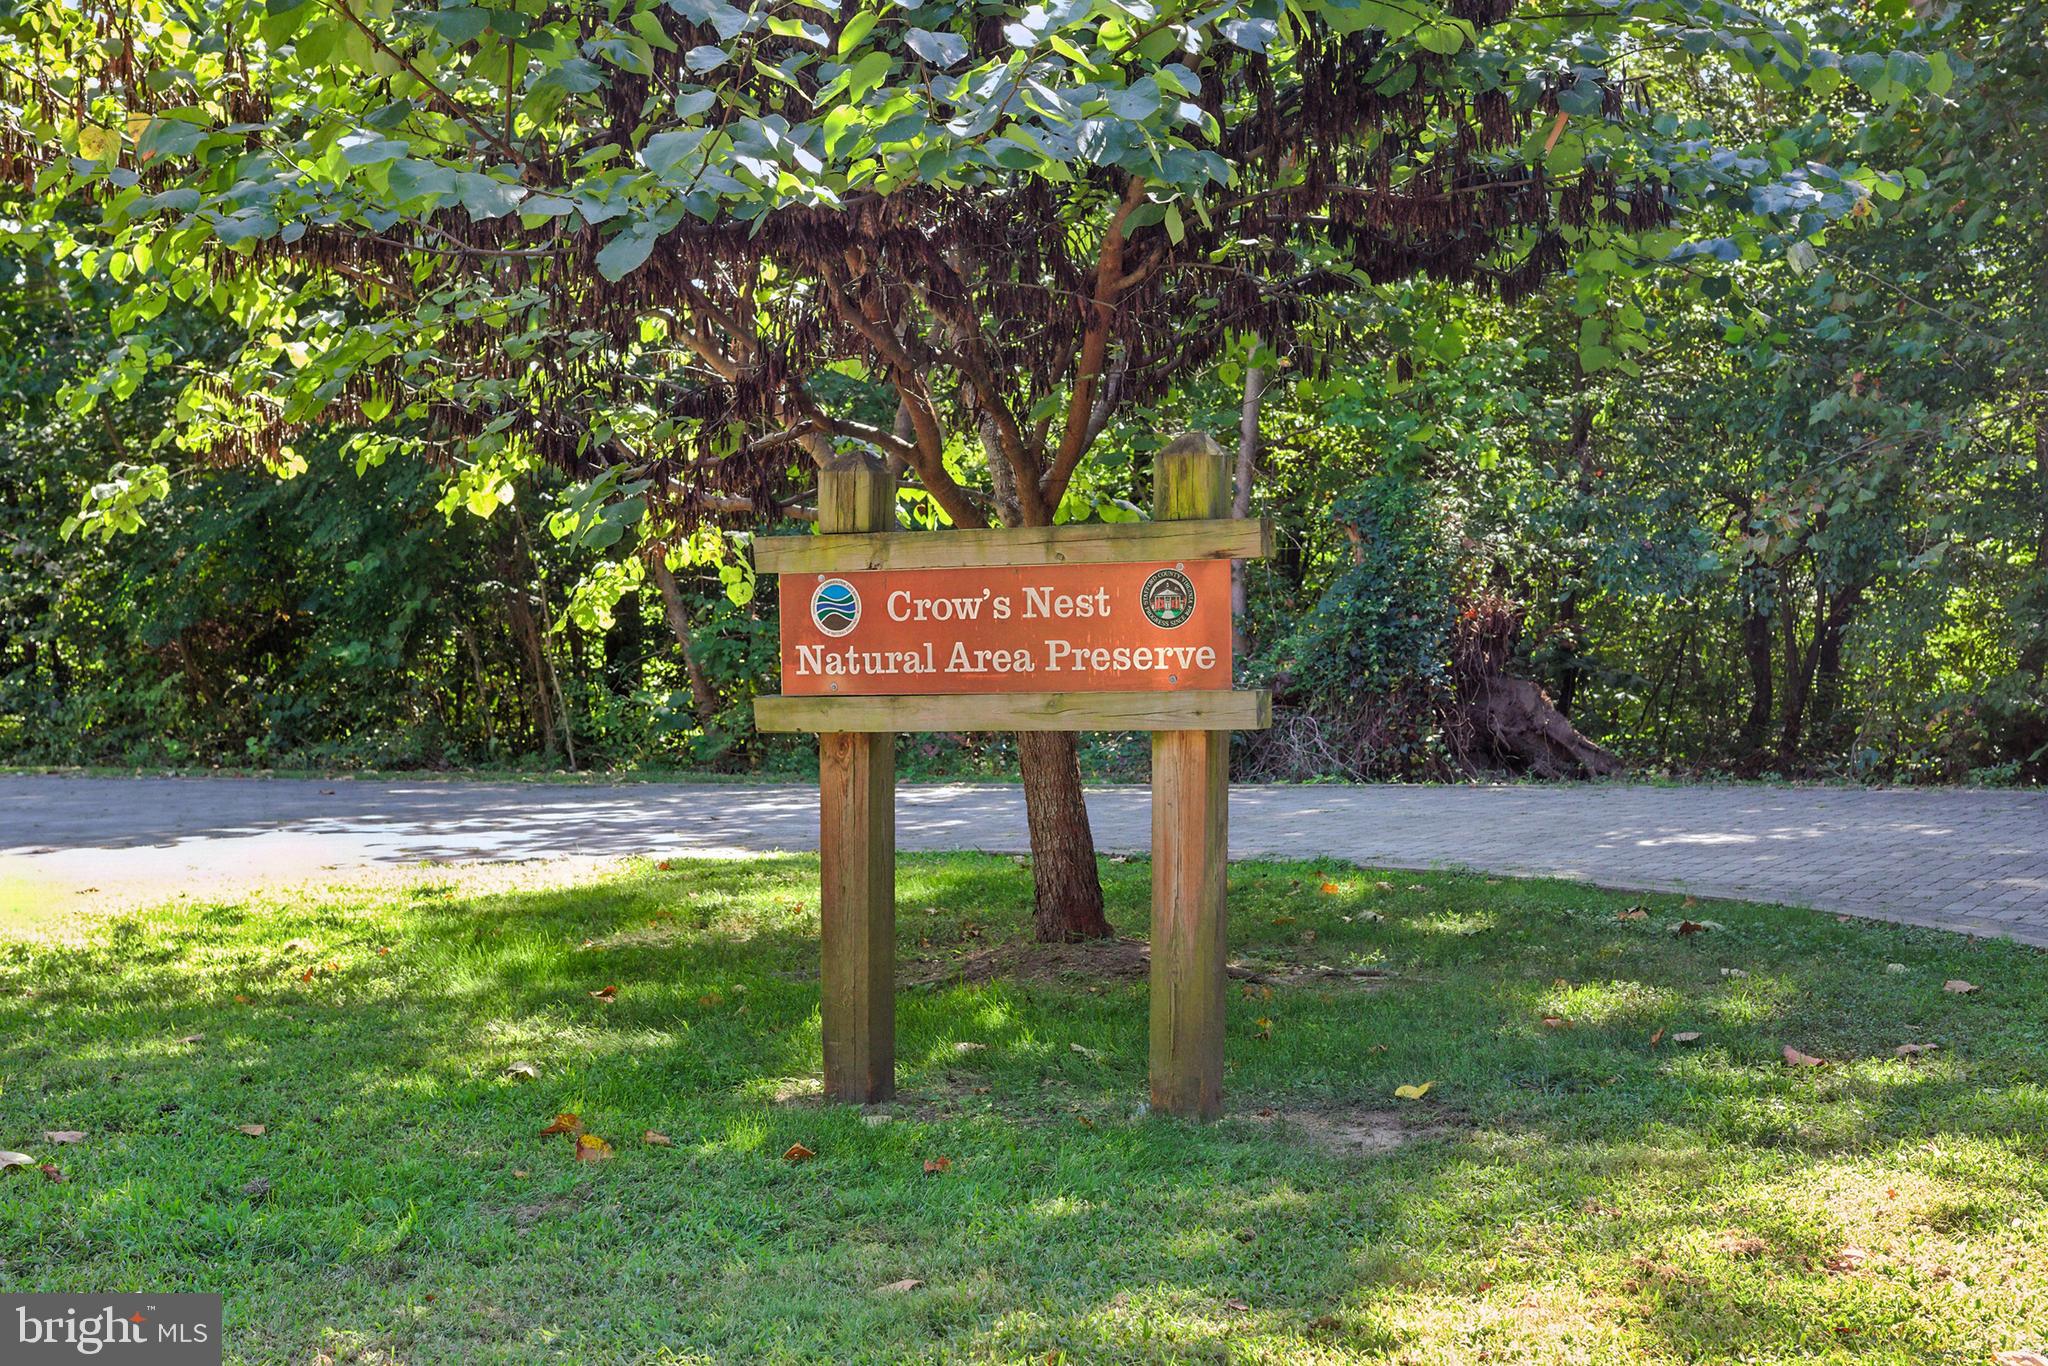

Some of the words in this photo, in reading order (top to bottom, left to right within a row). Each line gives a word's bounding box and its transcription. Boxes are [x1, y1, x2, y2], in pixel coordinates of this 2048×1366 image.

[889, 582, 1010, 624] Crow's
[1022, 586, 1111, 620] Nest
[795, 642, 935, 676] Natural
[945, 641, 1036, 674] Area
[1044, 637, 1216, 674] Preserve
